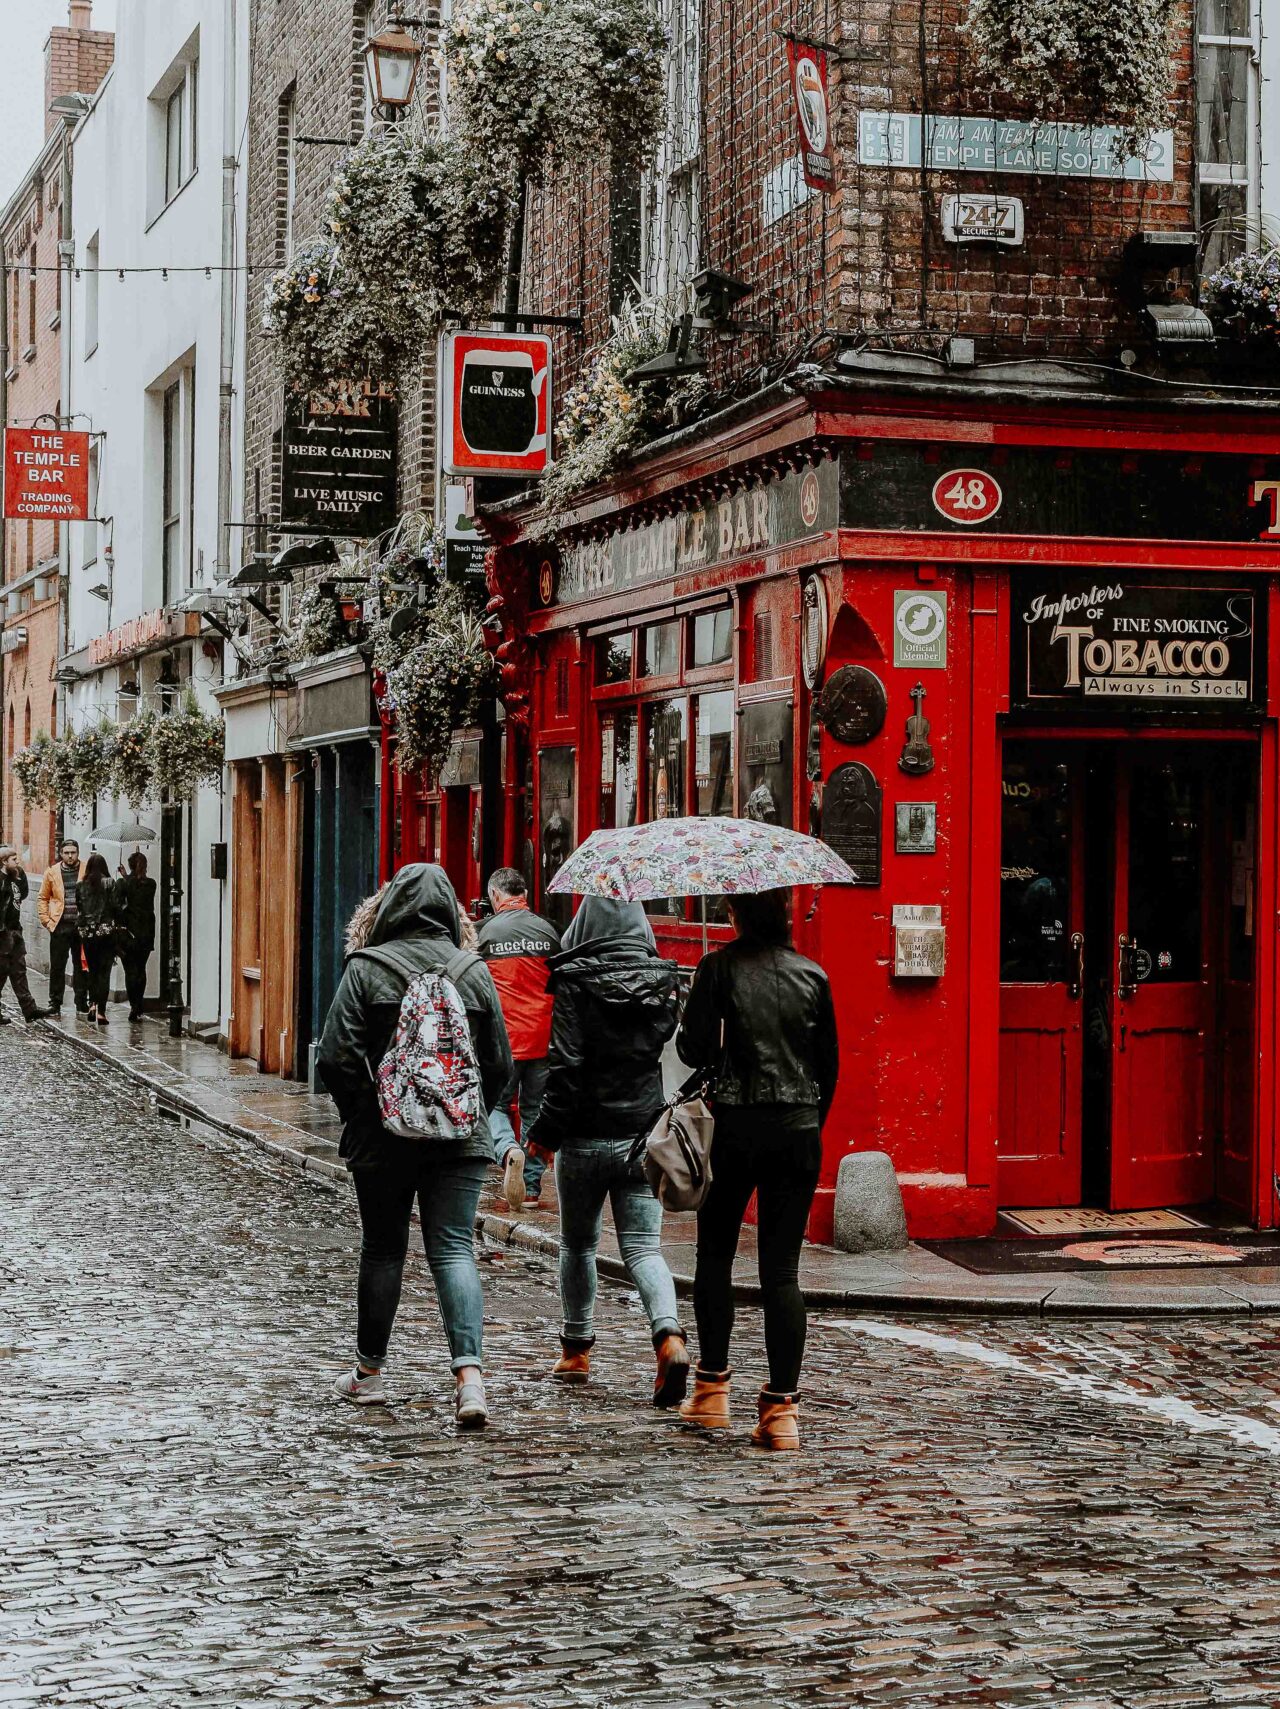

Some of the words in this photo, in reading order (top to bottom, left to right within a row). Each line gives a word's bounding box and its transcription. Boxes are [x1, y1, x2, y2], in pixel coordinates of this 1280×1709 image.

[971, 125, 993, 142] AN
[1003, 149, 1052, 168] LANE
[1149, 142, 1165, 167] 2
[469, 385, 525, 398] GUINNESS
[31, 435, 64, 449] THE
[13, 451, 80, 467] TEMPLE
[288, 444, 327, 457] BEER
[331, 446, 392, 460] GARDEN
[28, 469, 64, 483] BAR
[21, 492, 72, 503] TRADING
[293, 488, 330, 500] LIVE
[334, 489, 383, 502] MUSIC
[945, 478, 987, 511] 48
[17, 503, 75, 514] COMPANY
[316, 500, 362, 513] DAILY
[621, 512, 707, 580] TEMPLE
[718, 489, 769, 553] BAR
[453, 544, 471, 552] Teach
[1022, 583, 1124, 626] Importers
[1086, 608, 1104, 620] OF
[1113, 617, 1150, 632] FINE
[1154, 618, 1230, 634] SMOKING
[903, 651, 938, 660] Member
[905, 644, 936, 652] Official
[1050, 624, 1230, 688] TOBACCO
[1087, 678, 1155, 694] Always
[1166, 680, 1182, 694] in
[1190, 680, 1244, 696] Stock
[489, 938, 551, 954] raceface
